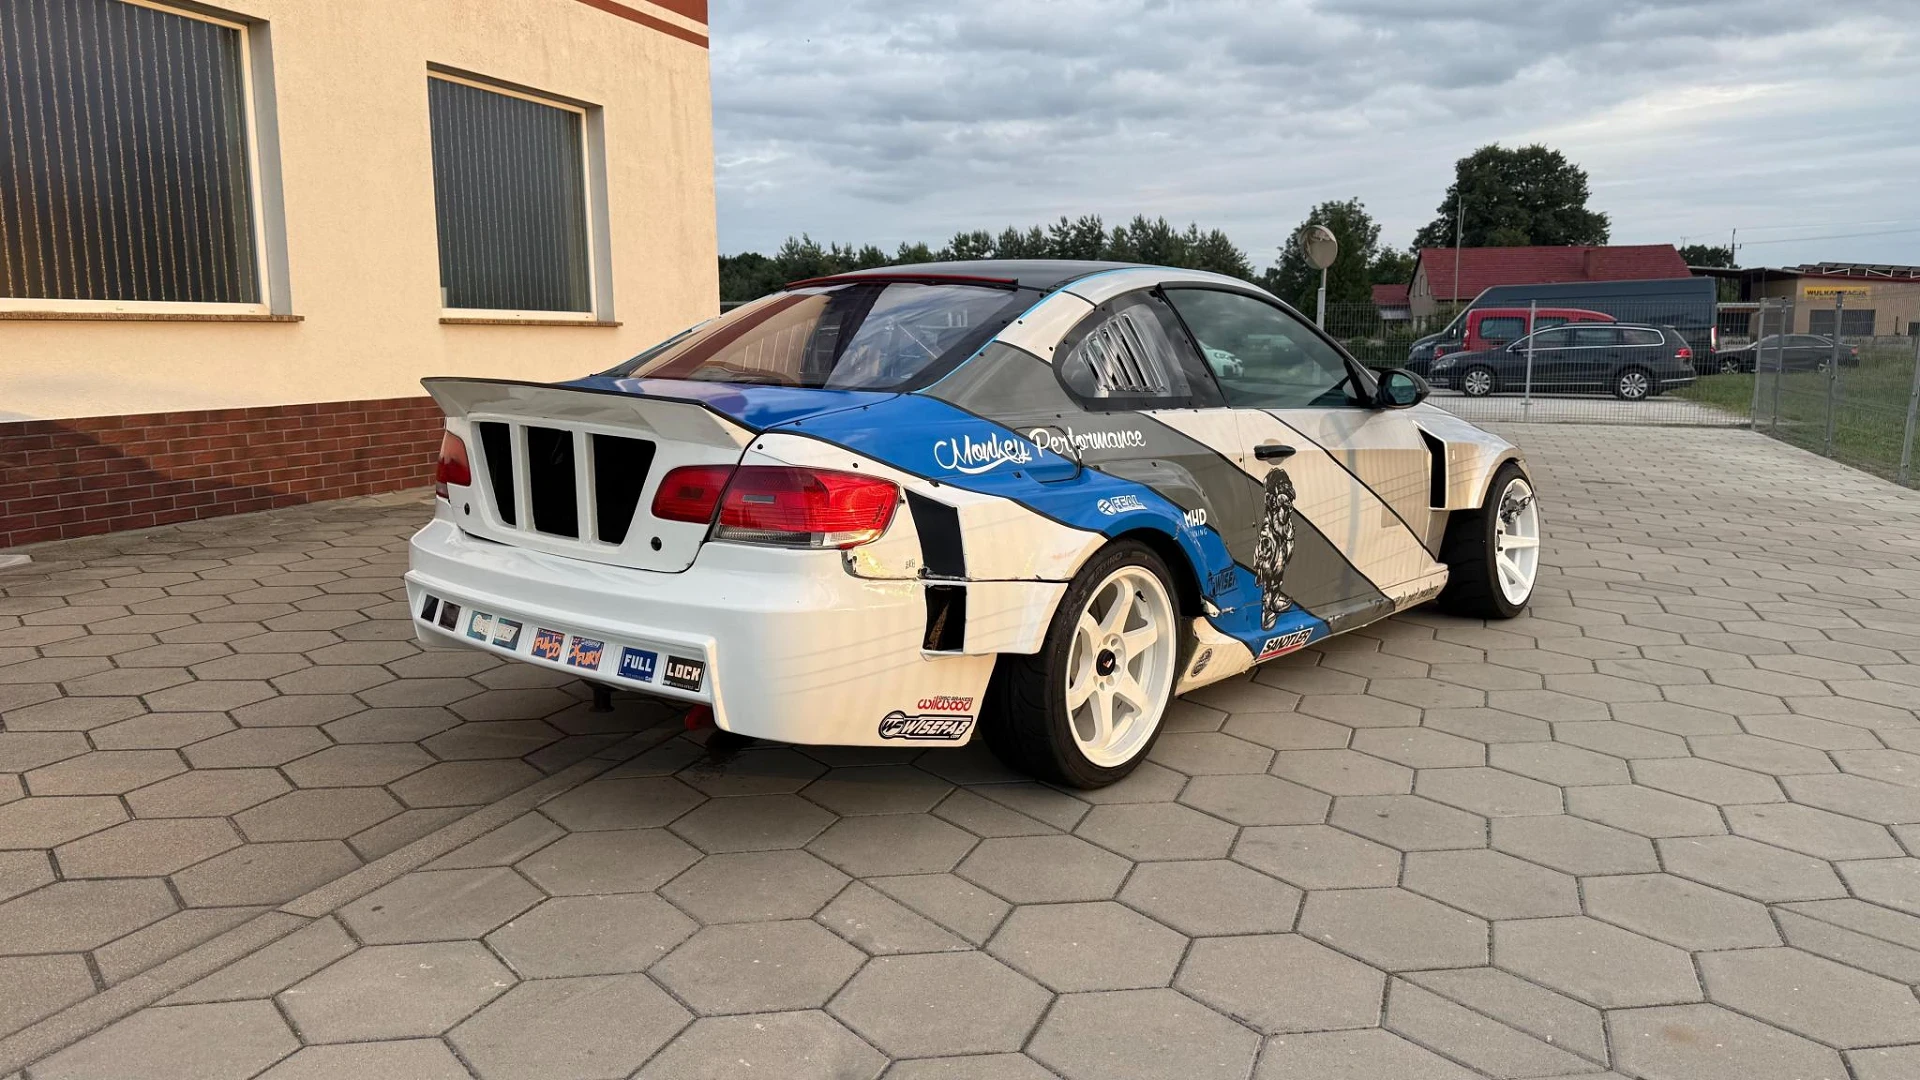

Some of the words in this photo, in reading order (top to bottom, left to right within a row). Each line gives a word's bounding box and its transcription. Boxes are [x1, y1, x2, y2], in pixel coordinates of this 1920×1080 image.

[934, 432, 1032, 474] Monkey
[1029, 426, 1146, 459] Performance
[1183, 508, 1207, 527] MHD
[623, 653, 652, 672] FULL
[666, 662, 701, 681] LOCK
[917, 696, 973, 712] wilwood
[901, 720, 971, 735] WISEFAB
